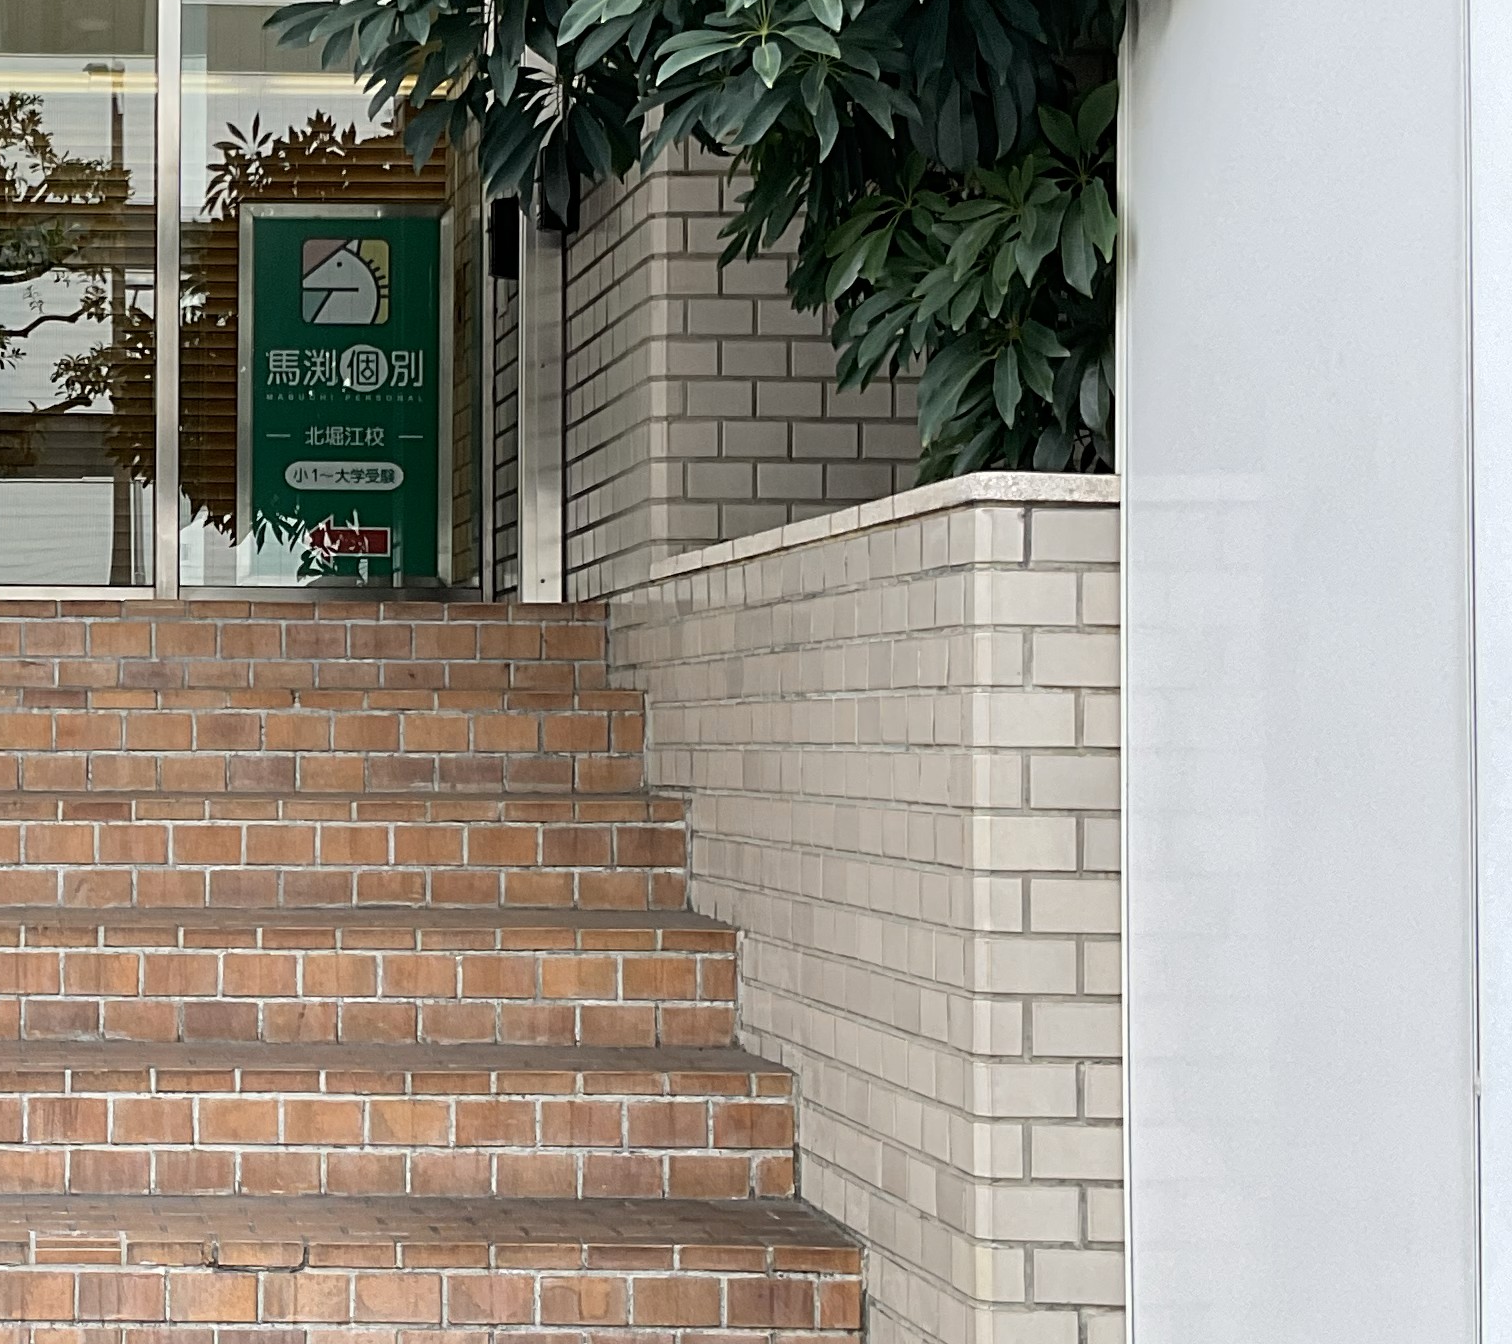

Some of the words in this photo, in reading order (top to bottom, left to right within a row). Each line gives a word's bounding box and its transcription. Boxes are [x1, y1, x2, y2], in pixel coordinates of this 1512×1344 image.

[266, 346, 424, 389] 馬渕個別
[265, 393, 335, 402] MABUCHI
[344, 393, 424, 403] PERSONAL
[304, 425, 386, 447] 北堀江校
